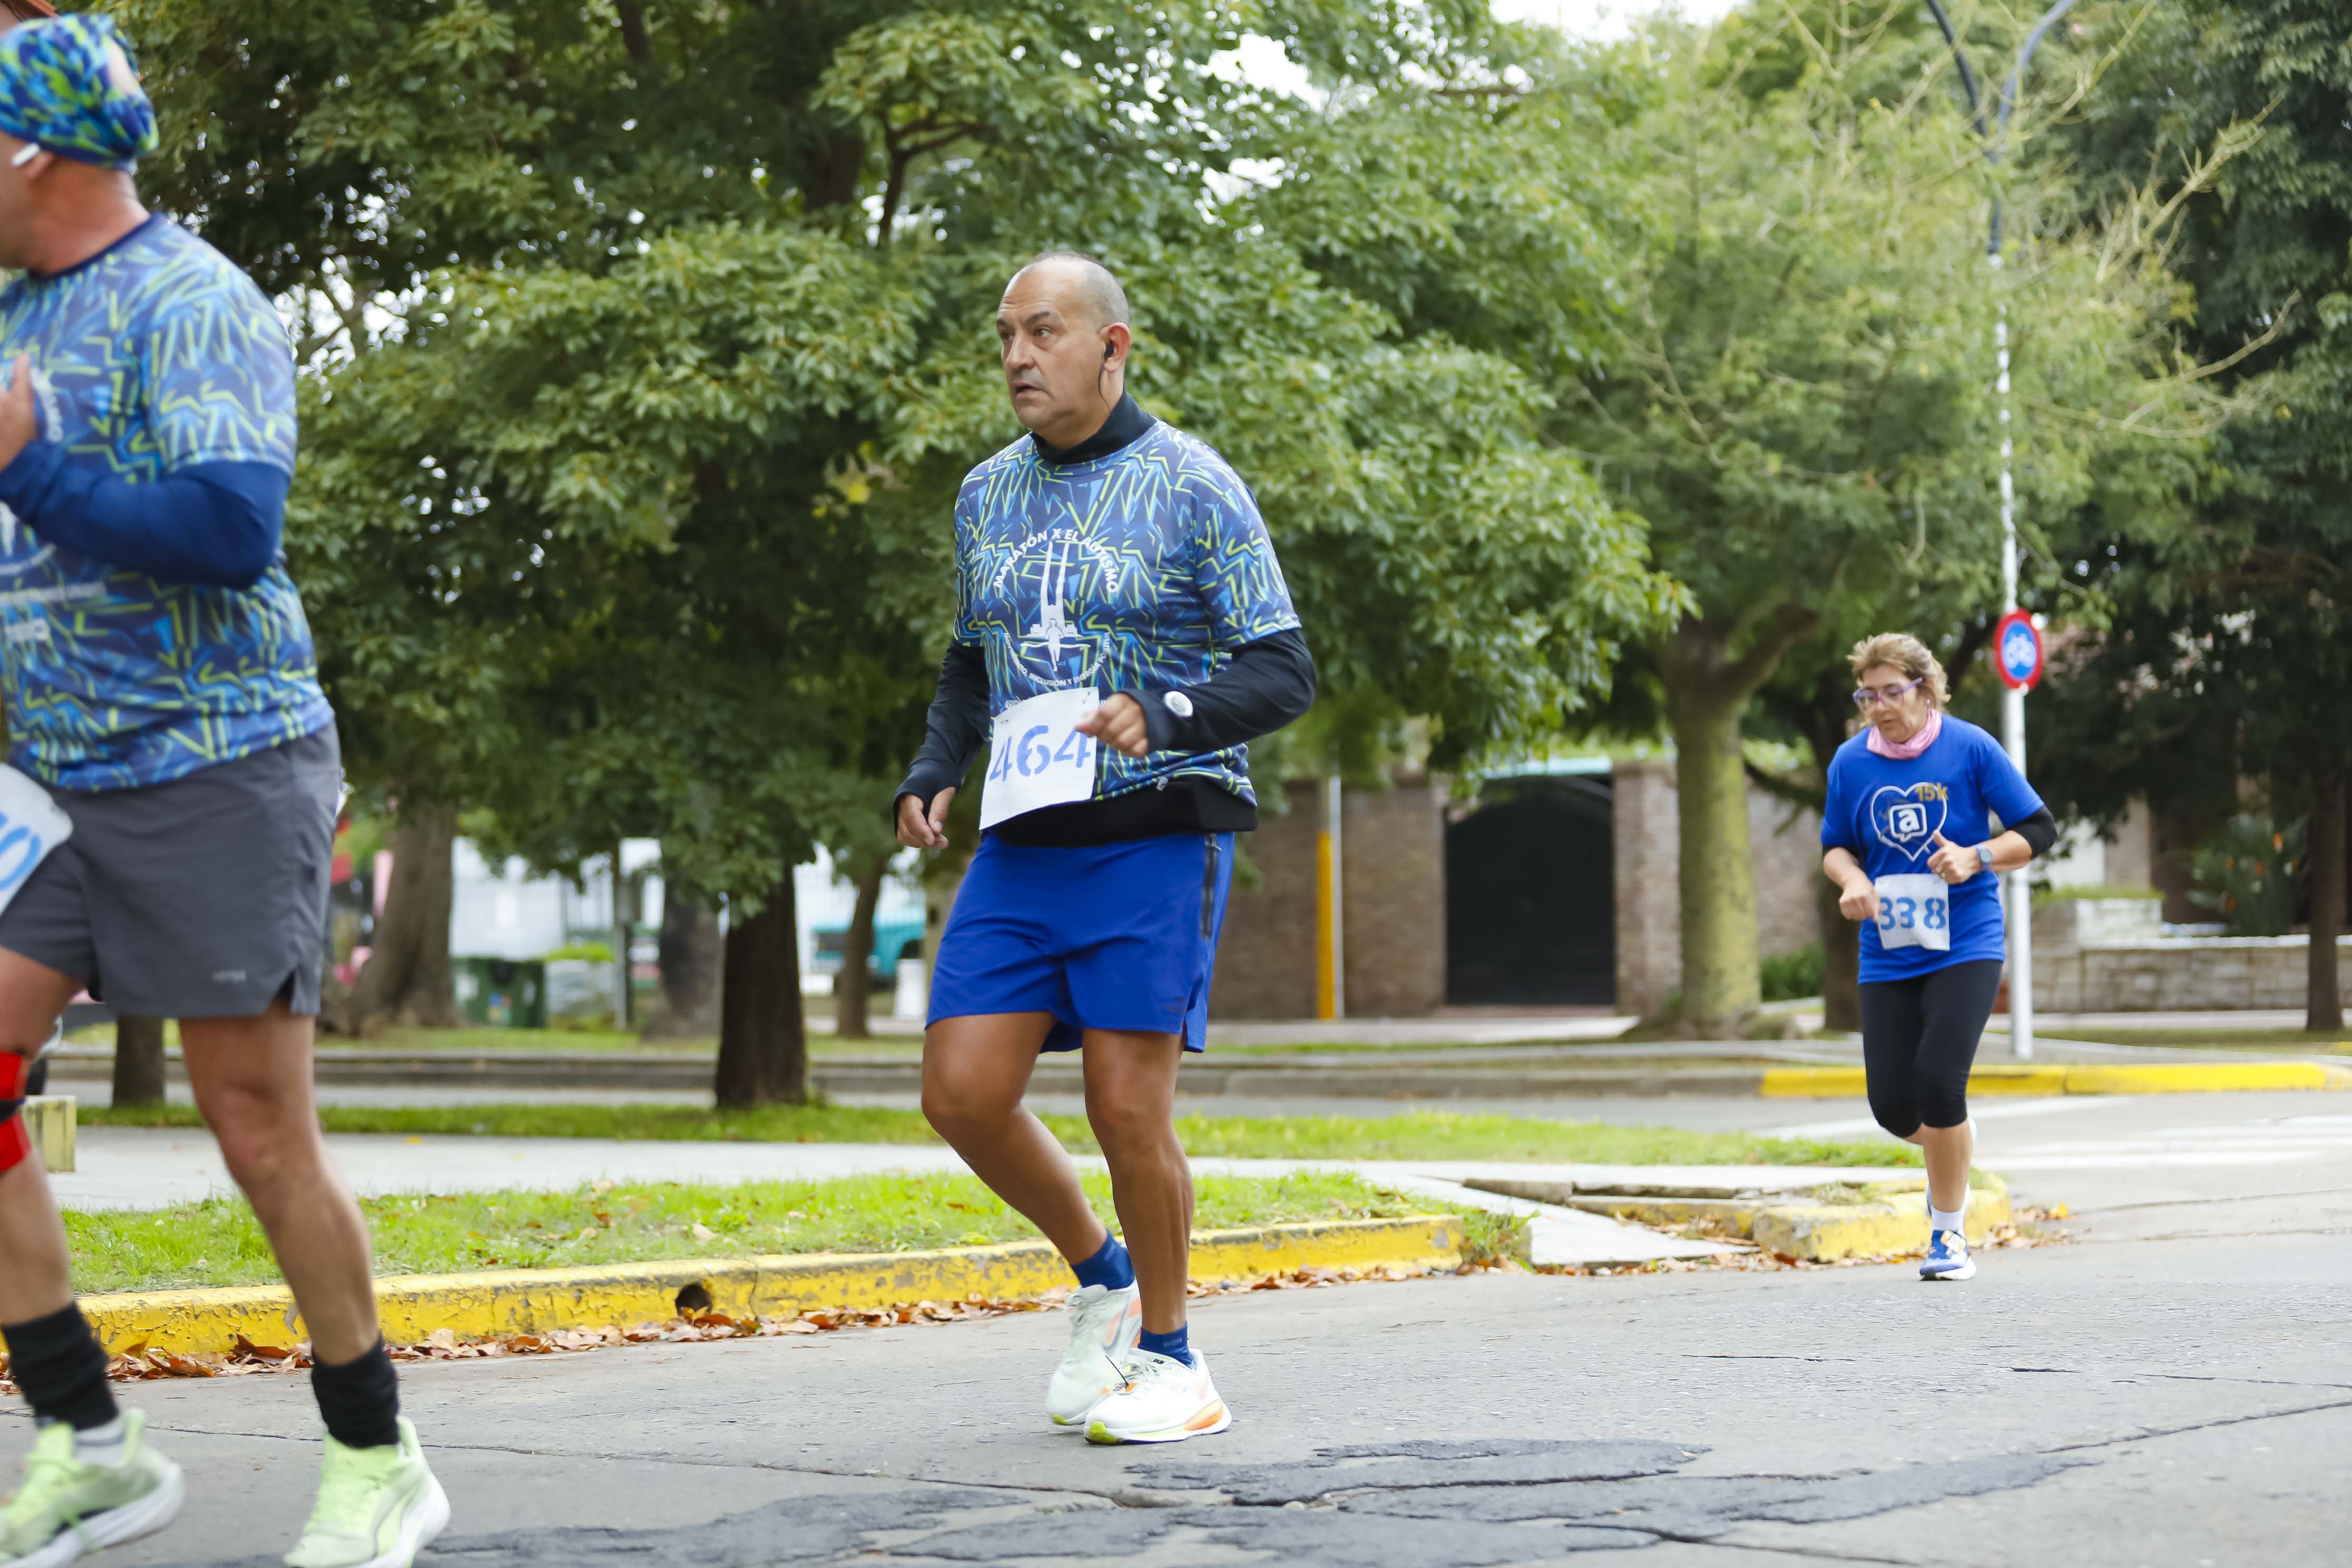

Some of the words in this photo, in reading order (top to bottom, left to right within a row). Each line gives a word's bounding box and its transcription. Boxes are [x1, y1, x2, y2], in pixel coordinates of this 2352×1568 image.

[1051, 528, 1062, 540] X
[1064, 528, 1079, 542] EL
[1082, 536, 1119, 593] AUTISMO
[989, 725, 1091, 782] 464
[1915, 782, 1948, 801] 15k
[1898, 808, 1920, 833] a
[1880, 896, 1946, 930] 338
